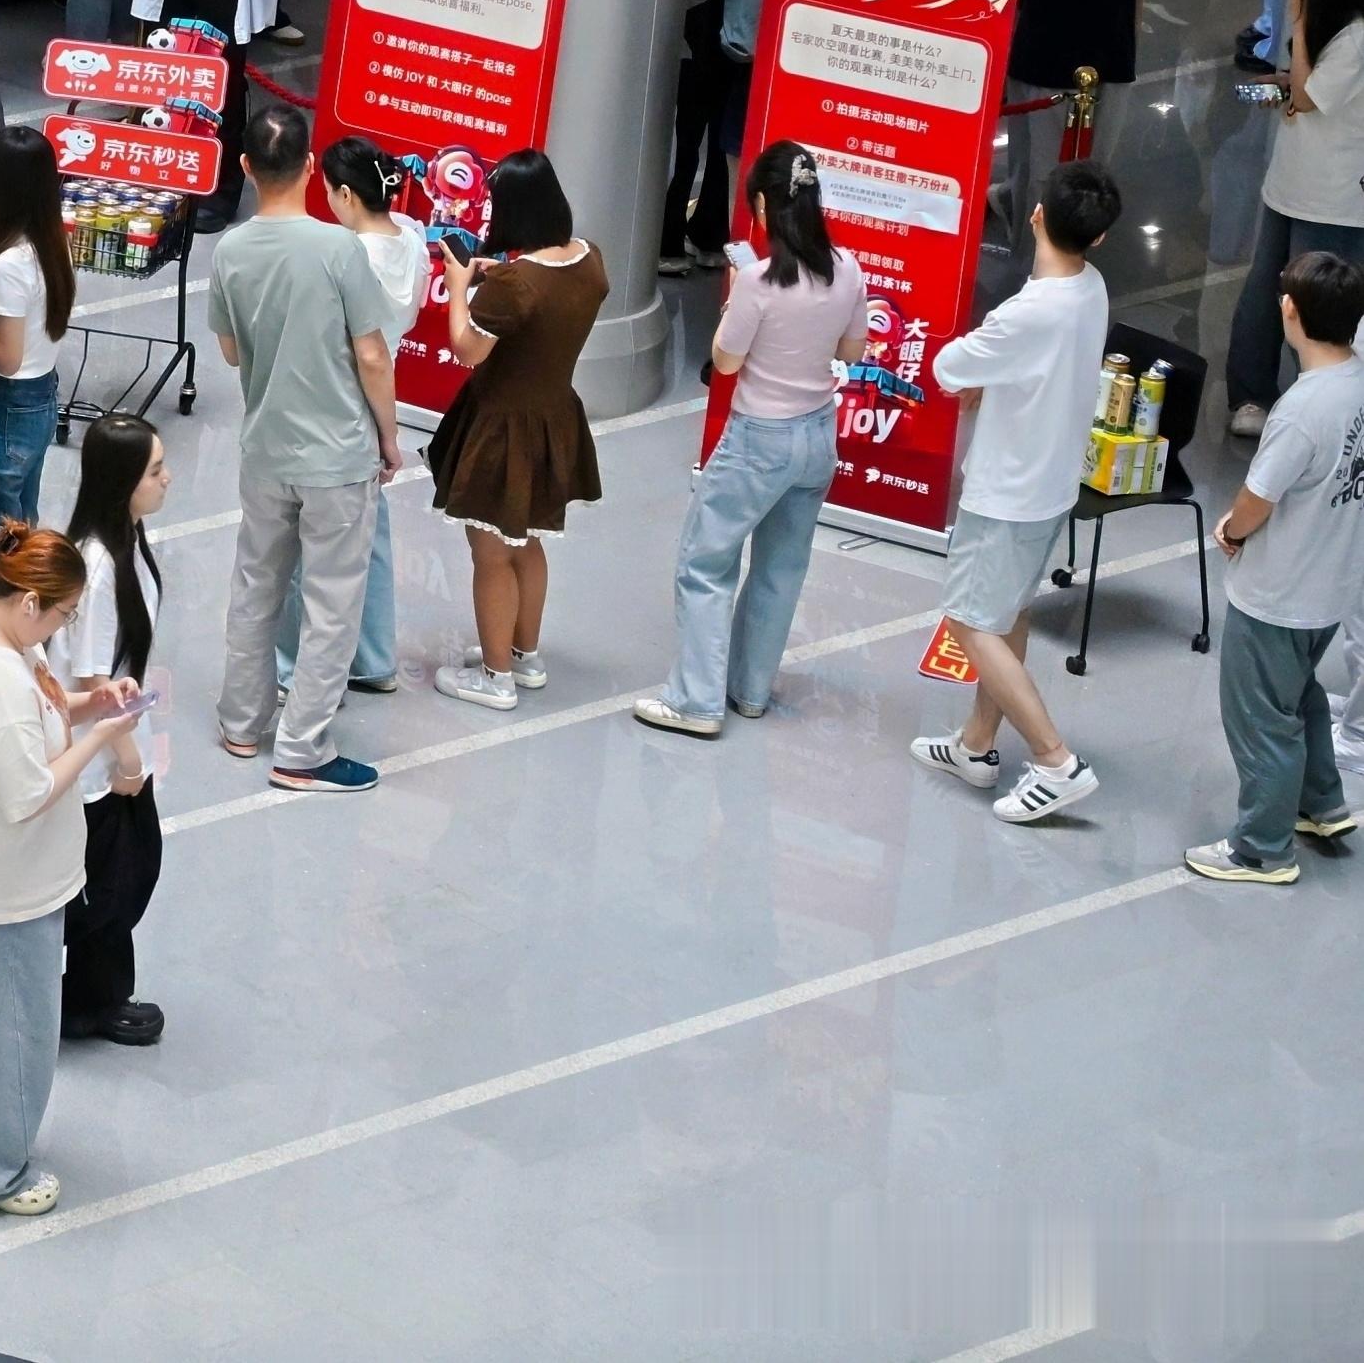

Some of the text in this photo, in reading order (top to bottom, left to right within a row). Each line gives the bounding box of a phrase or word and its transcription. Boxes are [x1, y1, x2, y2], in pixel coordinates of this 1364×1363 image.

[117, 59, 216, 90] 京东外卖
[404, 70, 425, 83] JOY
[427, 75, 438, 87] 和
[440, 79, 473, 96] 大眼仔
[836, 101, 930, 134] 拍摄活动现场图片
[102, 139, 200, 173] 京东秒送
[862, 140, 897, 159] 带话题
[811, 150, 950, 192] 外卖大牌请客狂撒千万份#
[895, 318, 930, 383] 大眼仔
[839, 398, 902, 443] joy
[882, 474, 930, 495] 京东秒送
